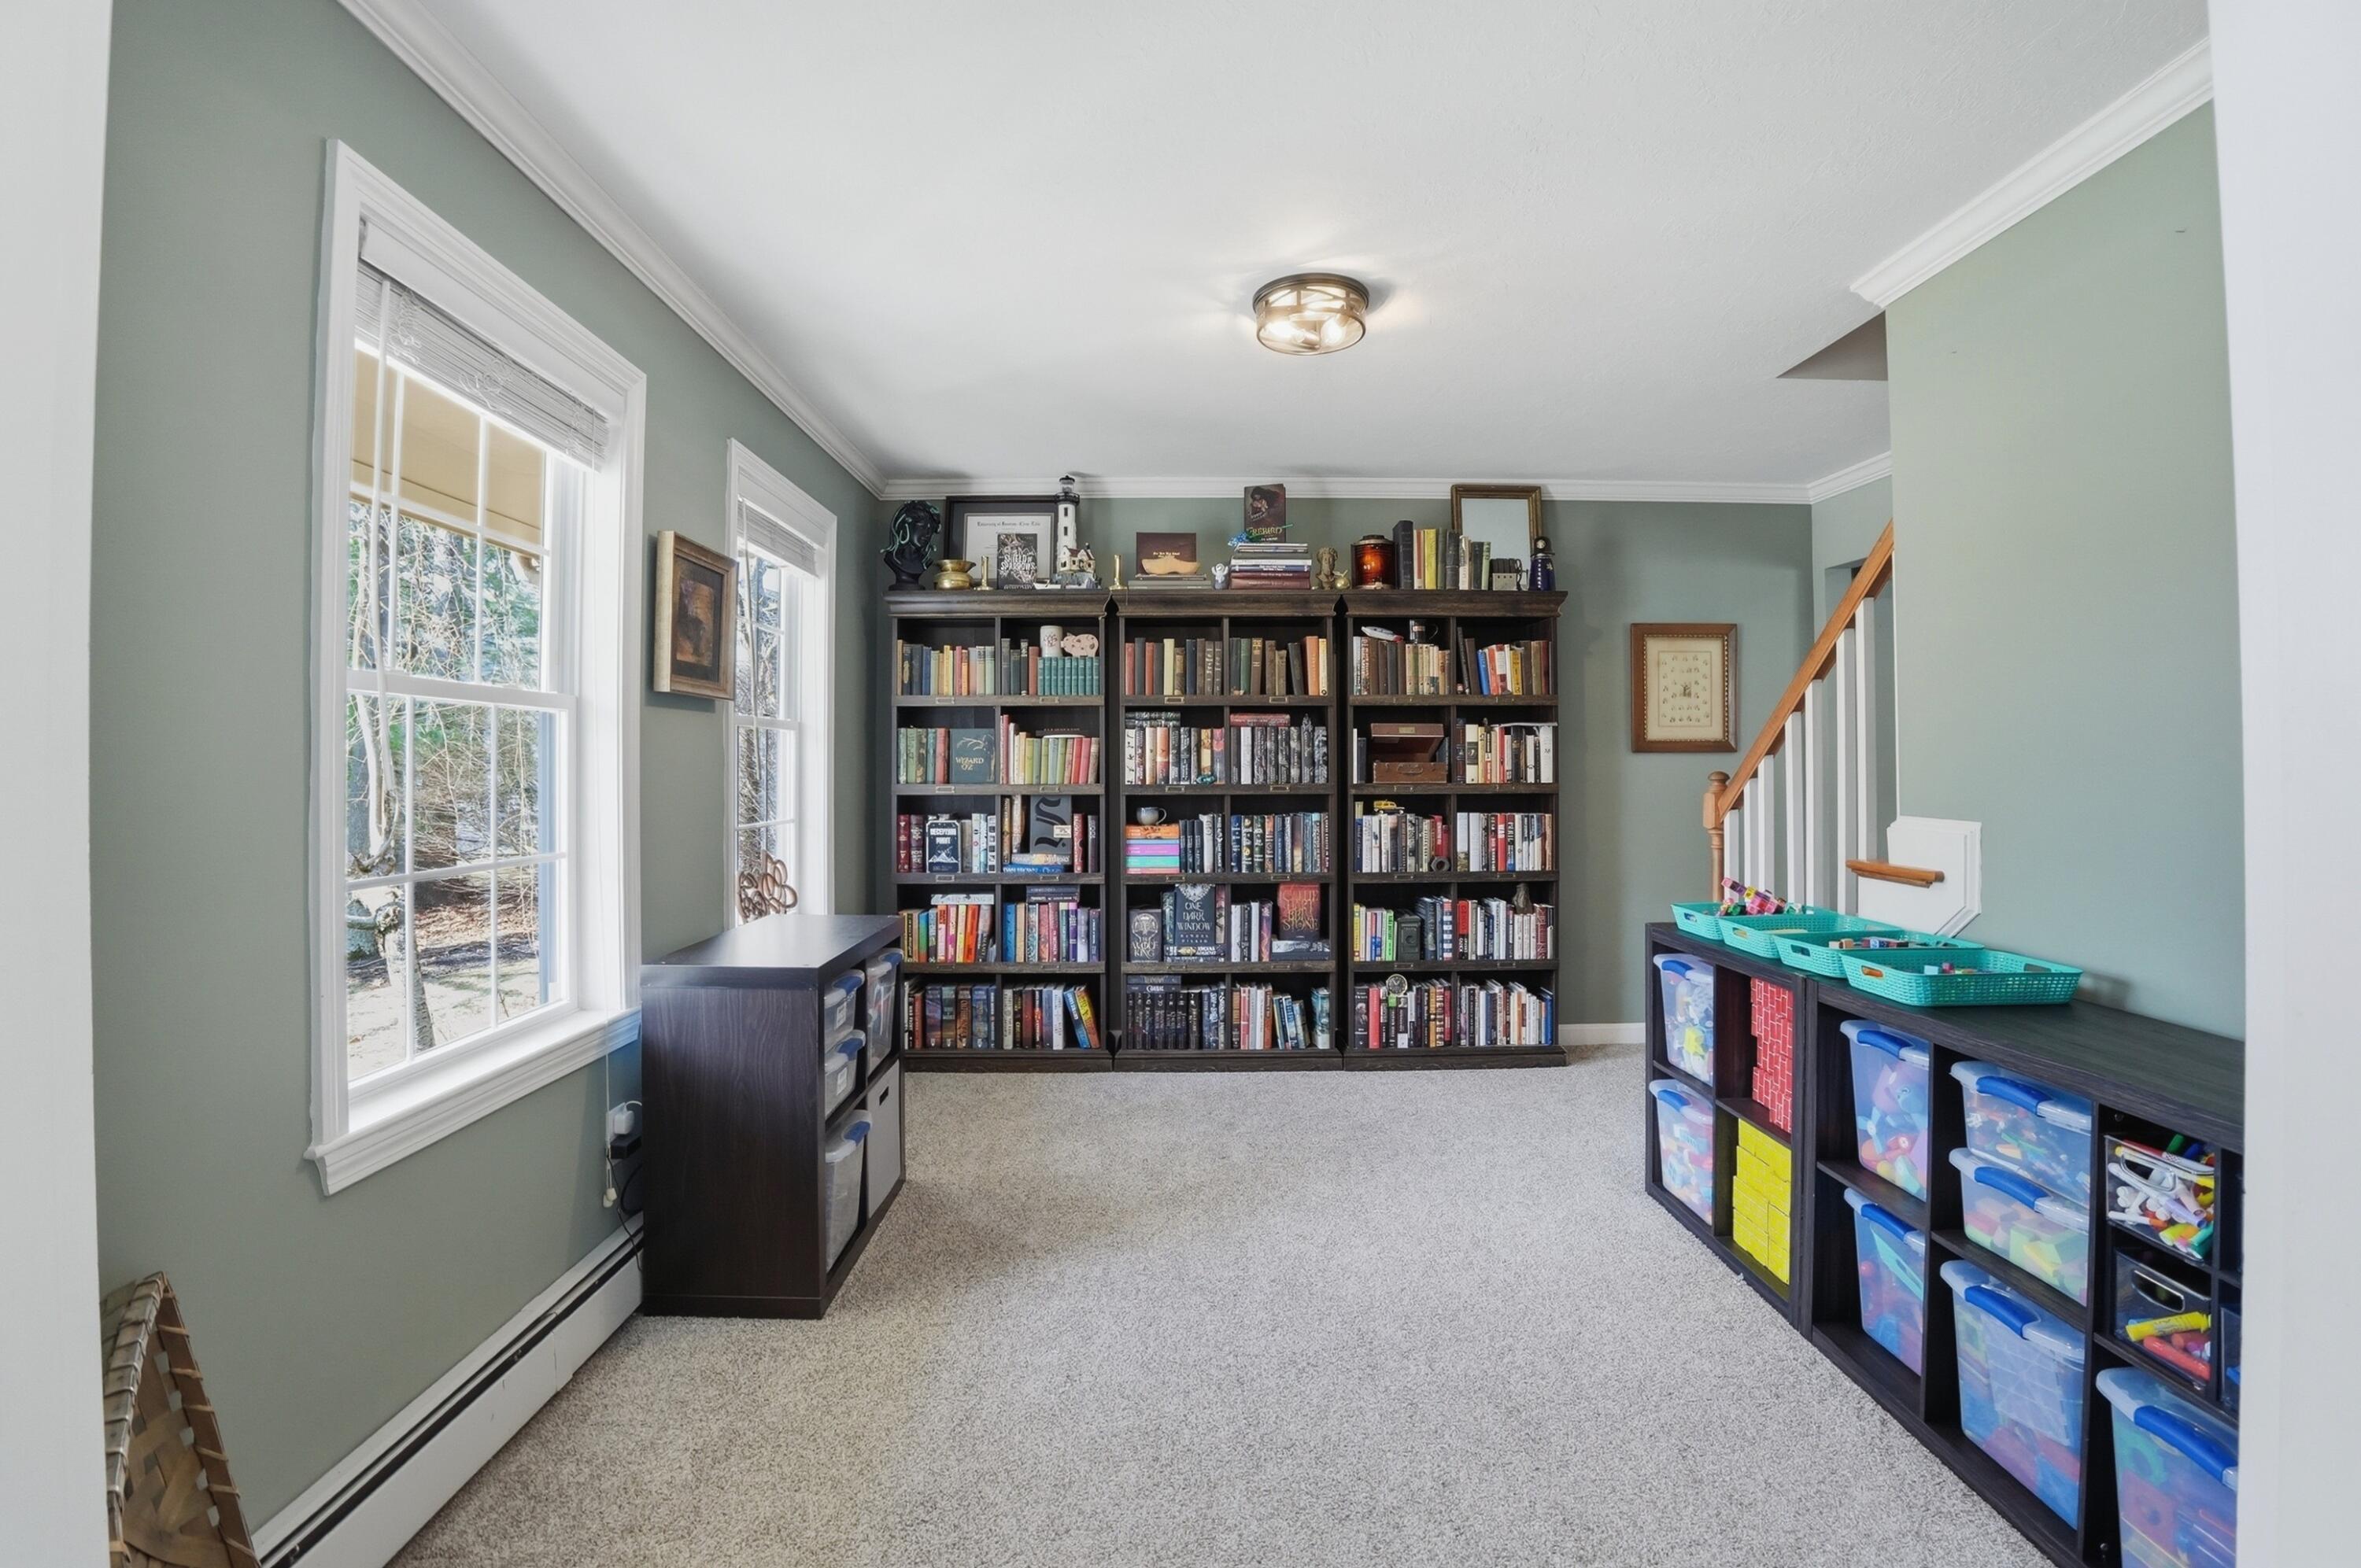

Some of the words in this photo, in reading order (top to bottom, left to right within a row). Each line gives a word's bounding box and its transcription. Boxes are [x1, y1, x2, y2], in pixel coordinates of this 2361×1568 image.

[1184, 902, 1203, 912] ONE
[1183, 911, 1205, 921] DARK
[1177, 921, 1212, 932] WINDOW
